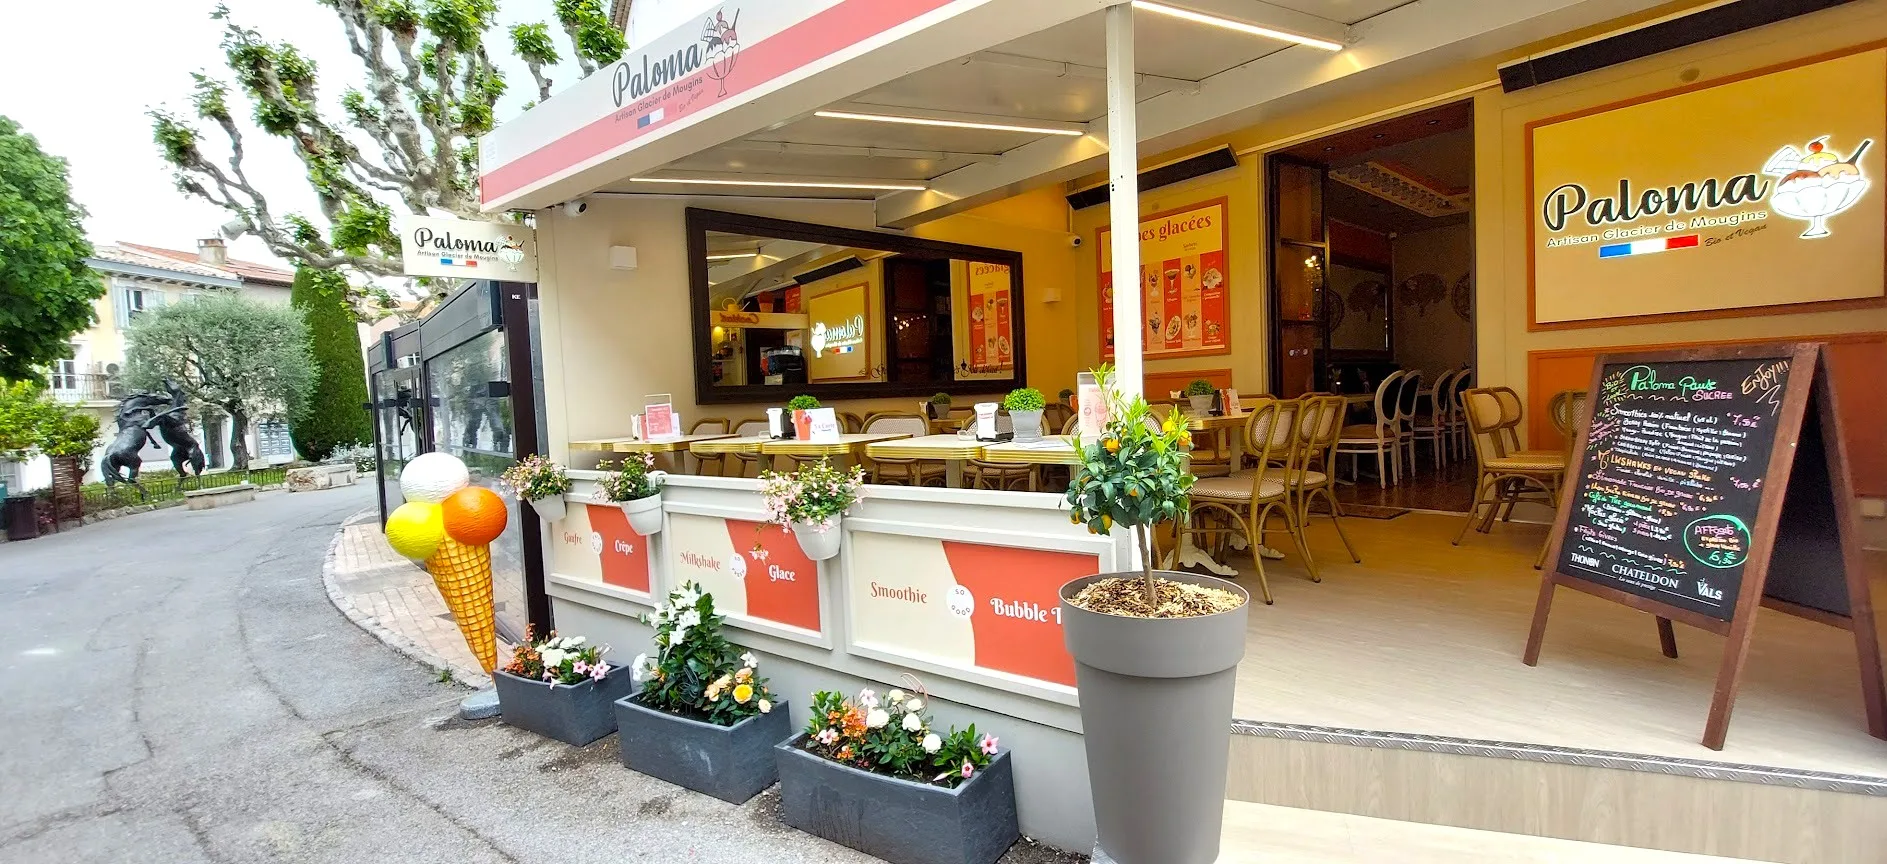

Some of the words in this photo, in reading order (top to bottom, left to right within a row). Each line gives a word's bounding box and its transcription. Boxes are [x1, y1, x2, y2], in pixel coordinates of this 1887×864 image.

[613, 43, 703, 107] Paloma
[615, 108, 637, 123] Artisan
[637, 96, 662, 112] Glacier
[662, 91, 671, 100] de
[672, 76, 703, 96] Mougins
[1543, 173, 1769, 232] Paloma
[414, 227, 499, 253] Paloma
[1158, 214, 1212, 242] glacées
[1546, 232, 1599, 248] Artisan
[1602, 223, 1661, 240] Glacier
[1665, 219, 1686, 231] de
[1689, 208, 1767, 229] Mougins
[1704, 236, 1722, 247] Bio
[1724, 232, 1736, 242] et
[1735, 223, 1768, 238] Vegan
[473, 254, 499, 262] Mougins
[1621, 365, 1676, 391] Paloma
[614, 538, 634, 556] Crêpe
[679, 550, 721, 571] Milkshake
[1571, 552, 1600, 568] THONON
[768, 564, 796, 582] Glace
[1611, 564, 1679, 589] CHATELDON
[870, 581, 927, 604] Smoothie
[1697, 581, 1723, 601] VALS
[990, 597, 1048, 623] Bubble
